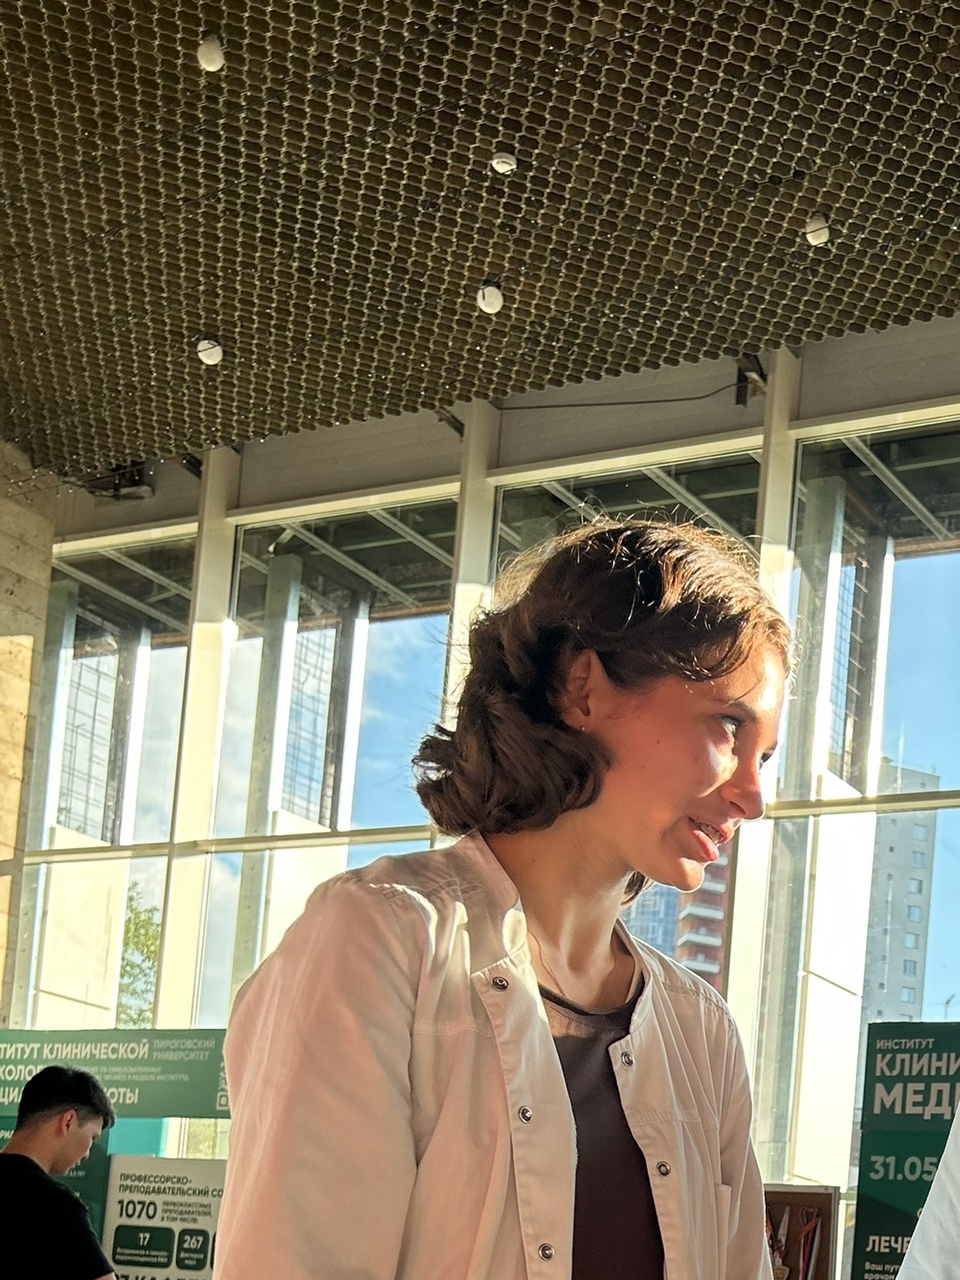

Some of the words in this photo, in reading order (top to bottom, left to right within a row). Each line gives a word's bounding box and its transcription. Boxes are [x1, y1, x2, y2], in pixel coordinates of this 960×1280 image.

[43, 1038, 150, 1060] КЛИНИЧЕСКОЙ
[153, 1038, 215, 1049] ПИРОГОВСКИЙ
[876, 1038, 935, 1050] ИНСТИТУТ
[153, 1050, 210, 1061] УНИВЕРСИТЕТ
[120, 1173, 192, 1185] ПРОФЕССОРСКО-
[118, 1184, 210, 1198] ПРЕПОДАВАТЕЛЬСКИЙ
[118, 1199, 157, 1220] 1070
[139, 1232, 150, 1247] 17
[183, 1235, 204, 1249] 267
[865, 1261, 883, 1271] Ваш
